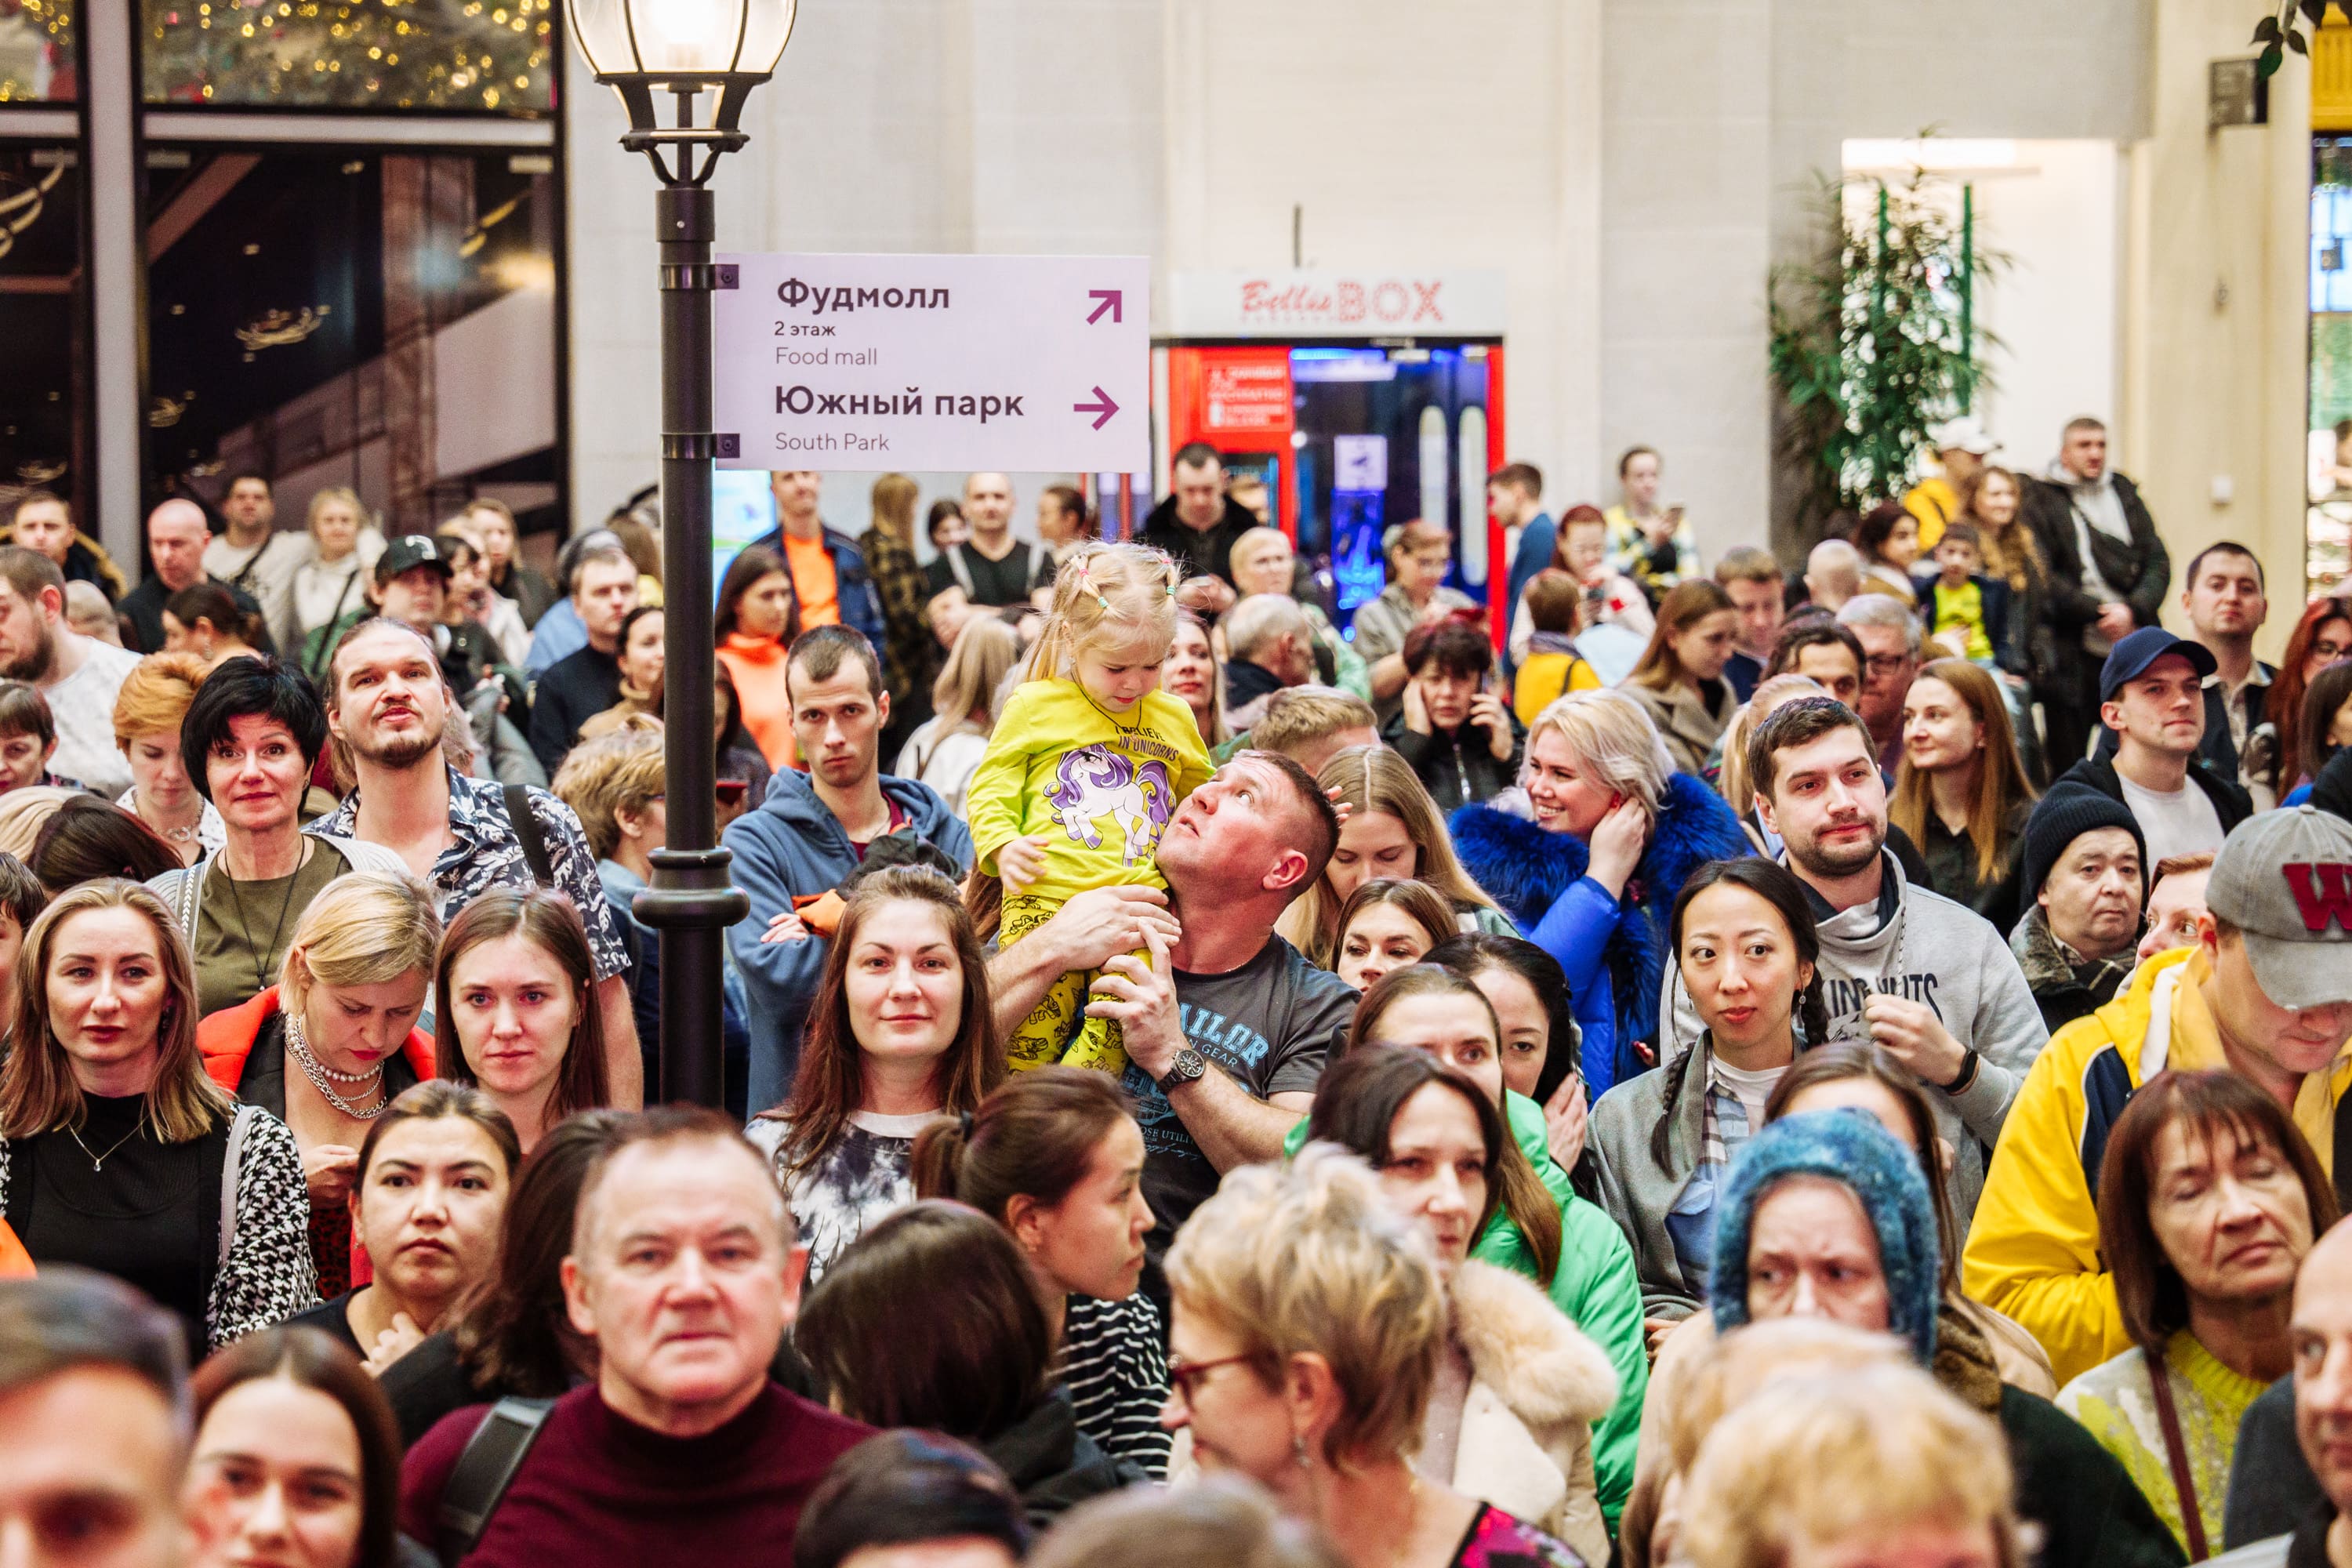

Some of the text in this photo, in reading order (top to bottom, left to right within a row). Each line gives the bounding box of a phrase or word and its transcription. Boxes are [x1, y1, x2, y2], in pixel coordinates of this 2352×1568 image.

[777, 278, 950, 315] Фудмолл
[1337, 281, 1444, 322] BOX
[775, 321, 837, 338] 2 этаж
[776, 347, 877, 365] Food mall
[775, 385, 1025, 424] Южный парк
[775, 432, 890, 452] South Park
[1118, 735, 1179, 762] IN UNICORNS
[2281, 863, 2352, 931] W
[1201, 1044, 1239, 1068] GEAR
